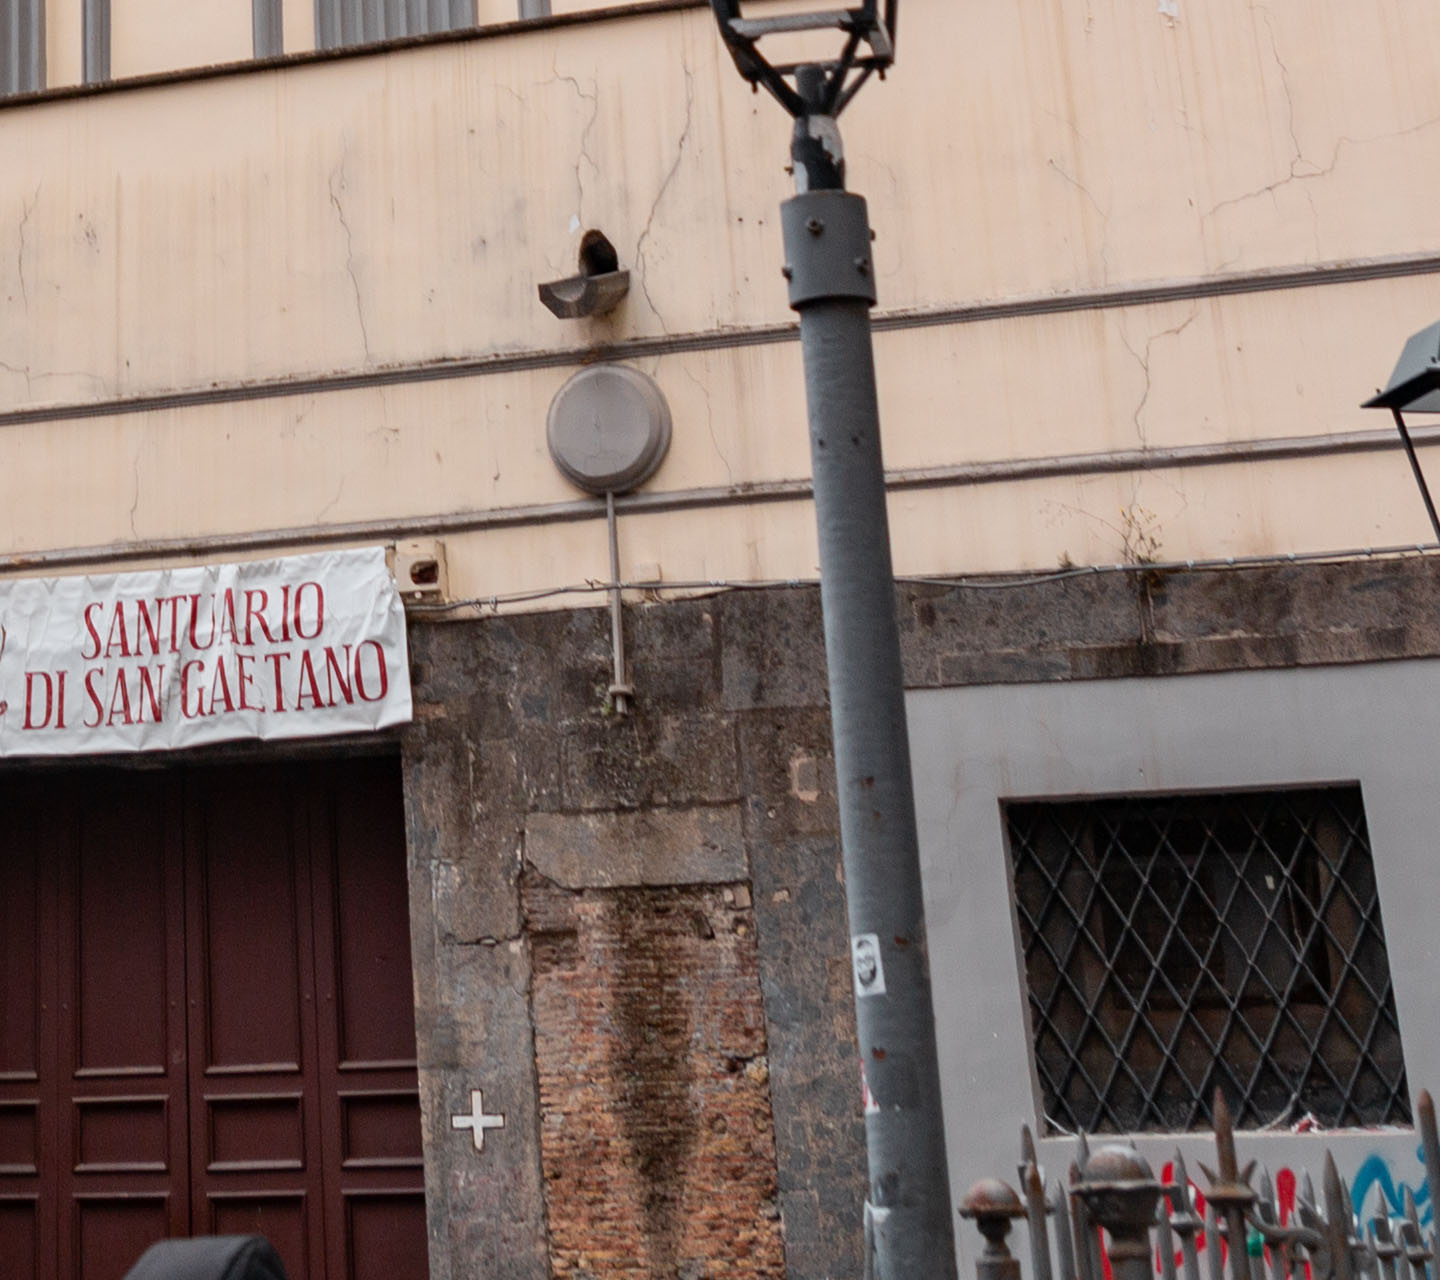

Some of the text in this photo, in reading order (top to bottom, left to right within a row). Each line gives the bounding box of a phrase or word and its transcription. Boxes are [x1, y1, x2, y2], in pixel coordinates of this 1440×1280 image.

[81, 581, 325, 660] SANTUARIO
[22, 639, 390, 731] DI SAN GAETANO
